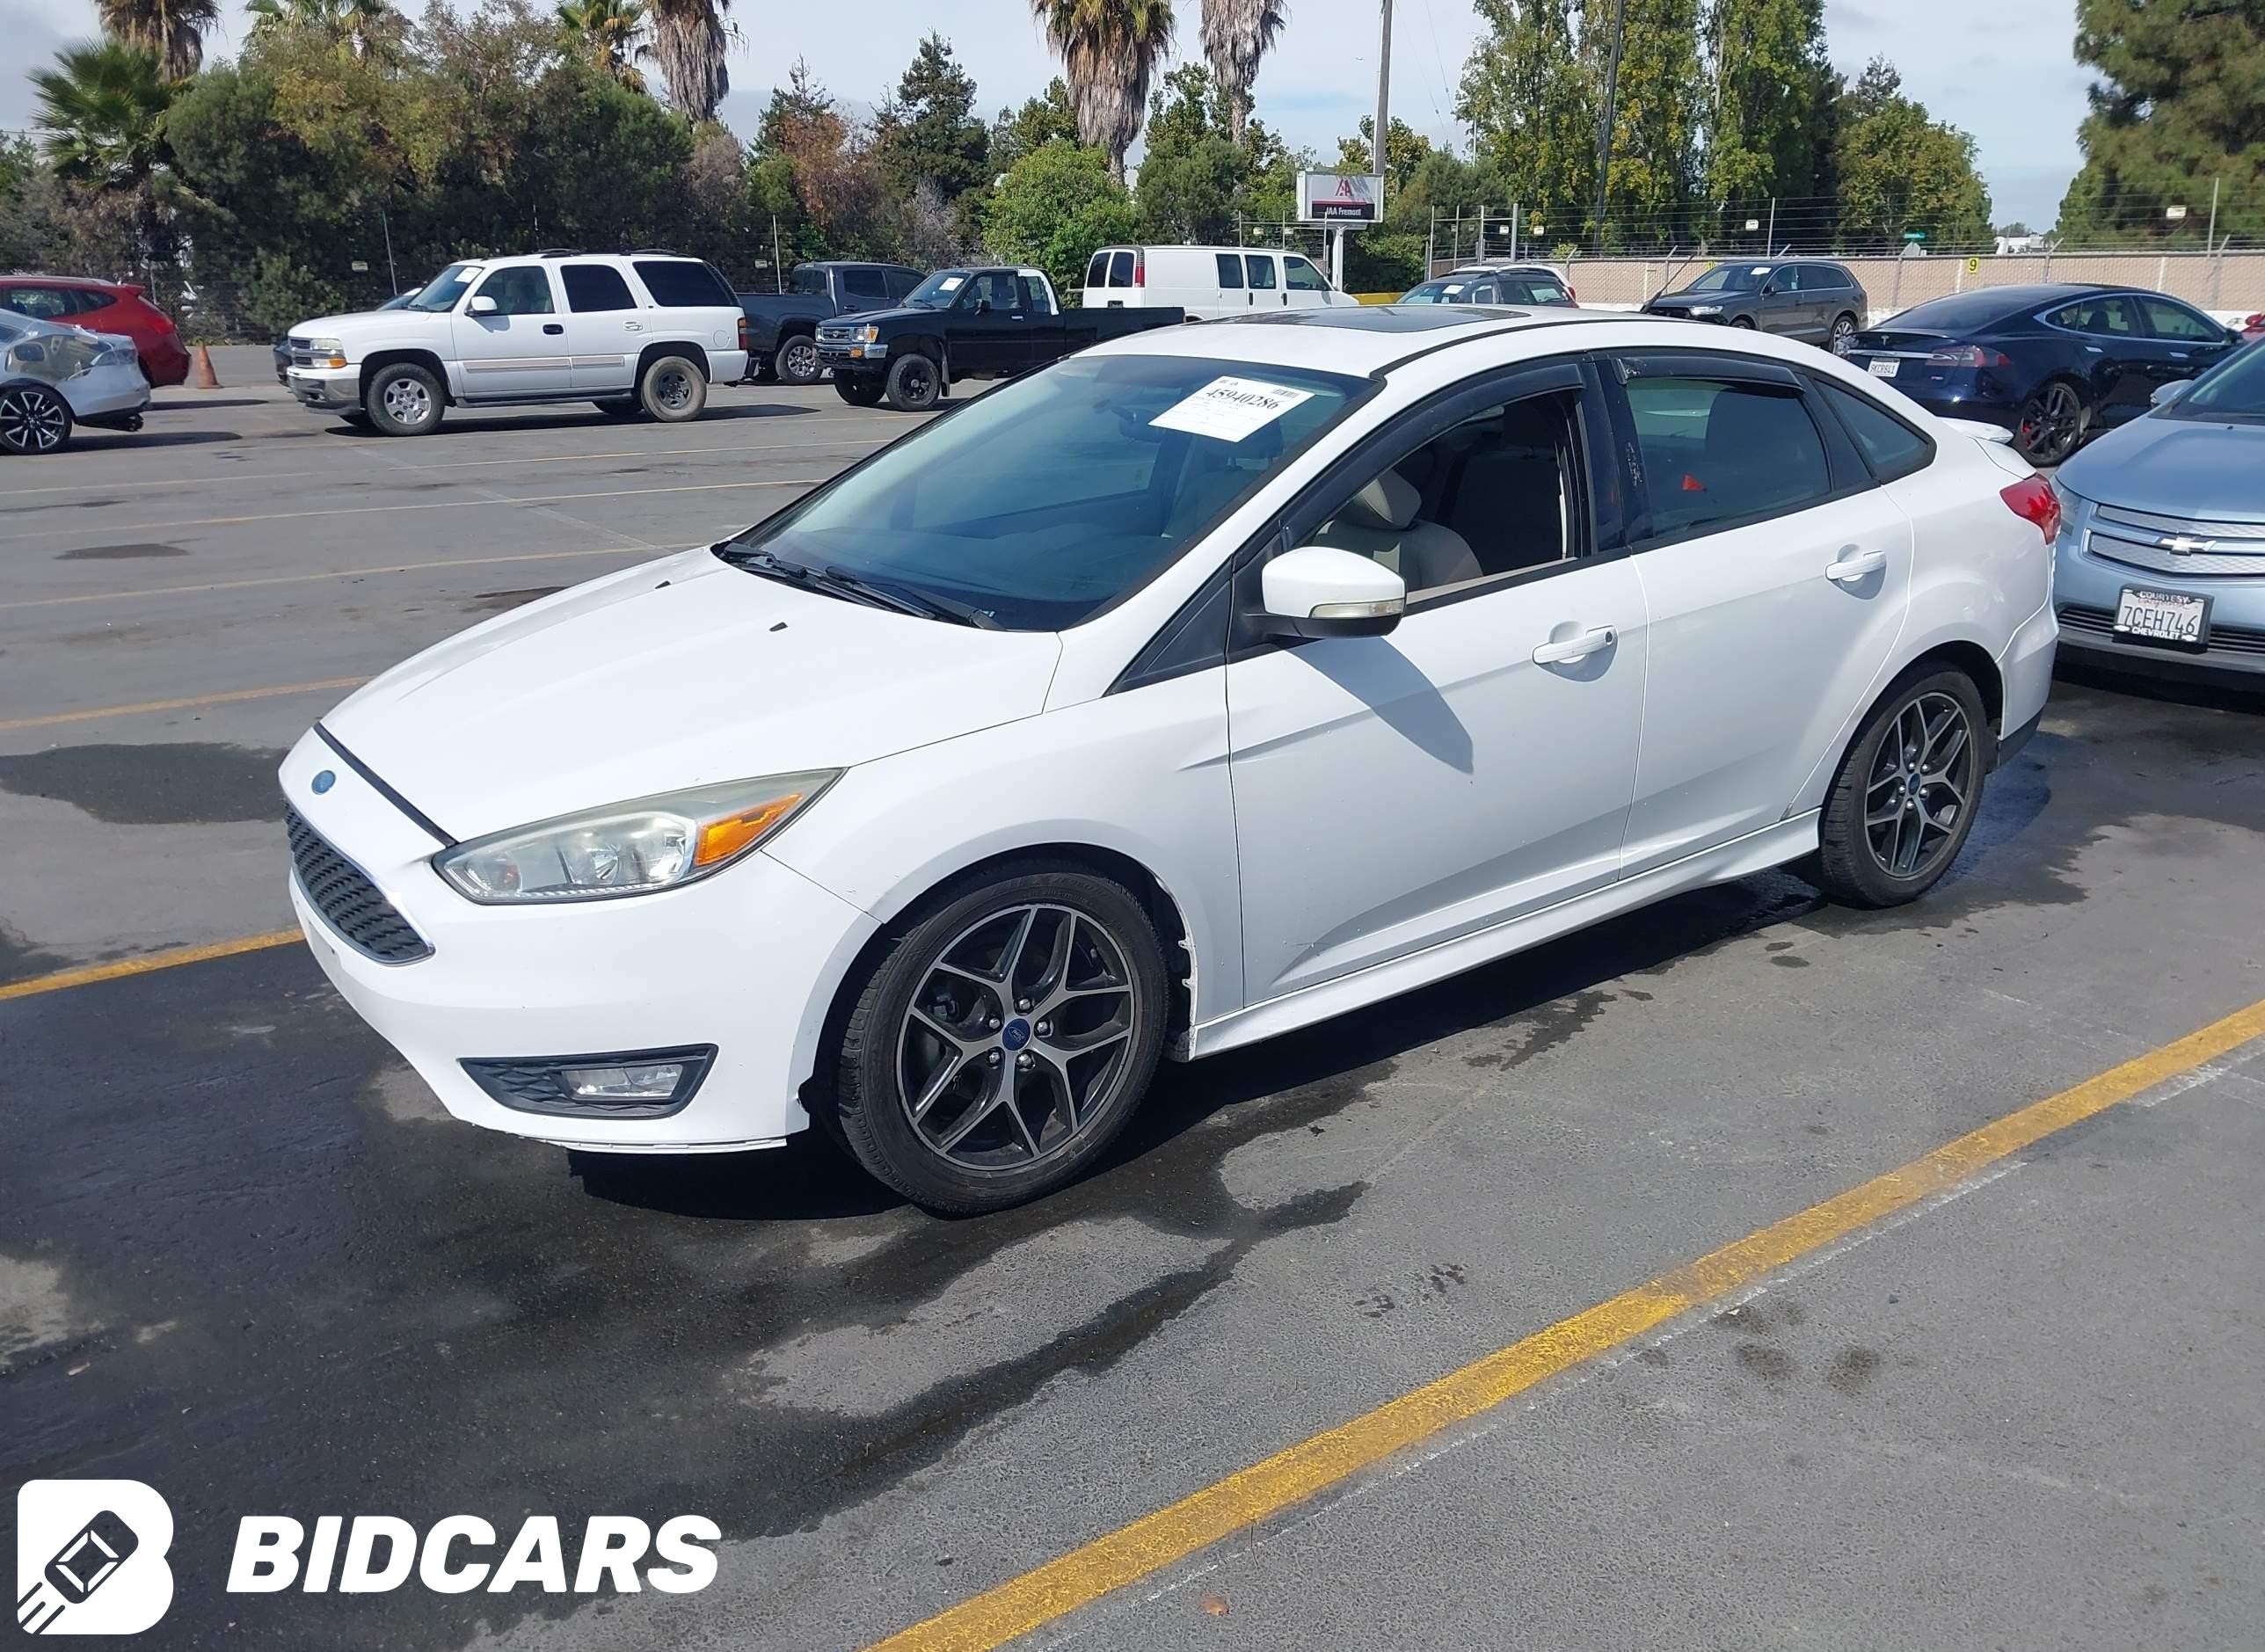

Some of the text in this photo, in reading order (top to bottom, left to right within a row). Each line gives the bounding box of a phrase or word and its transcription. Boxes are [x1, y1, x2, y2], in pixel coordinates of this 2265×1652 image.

[1338, 207, 1362, 216] Fremont
[1970, 259, 1977, 271] 9
[1205, 388, 1285, 410] 45940286
[2138, 590, 2189, 604] COURTESY
[2123, 605, 2199, 634] 7CEH746
[2131, 625, 2181, 641] CHEVROLET
